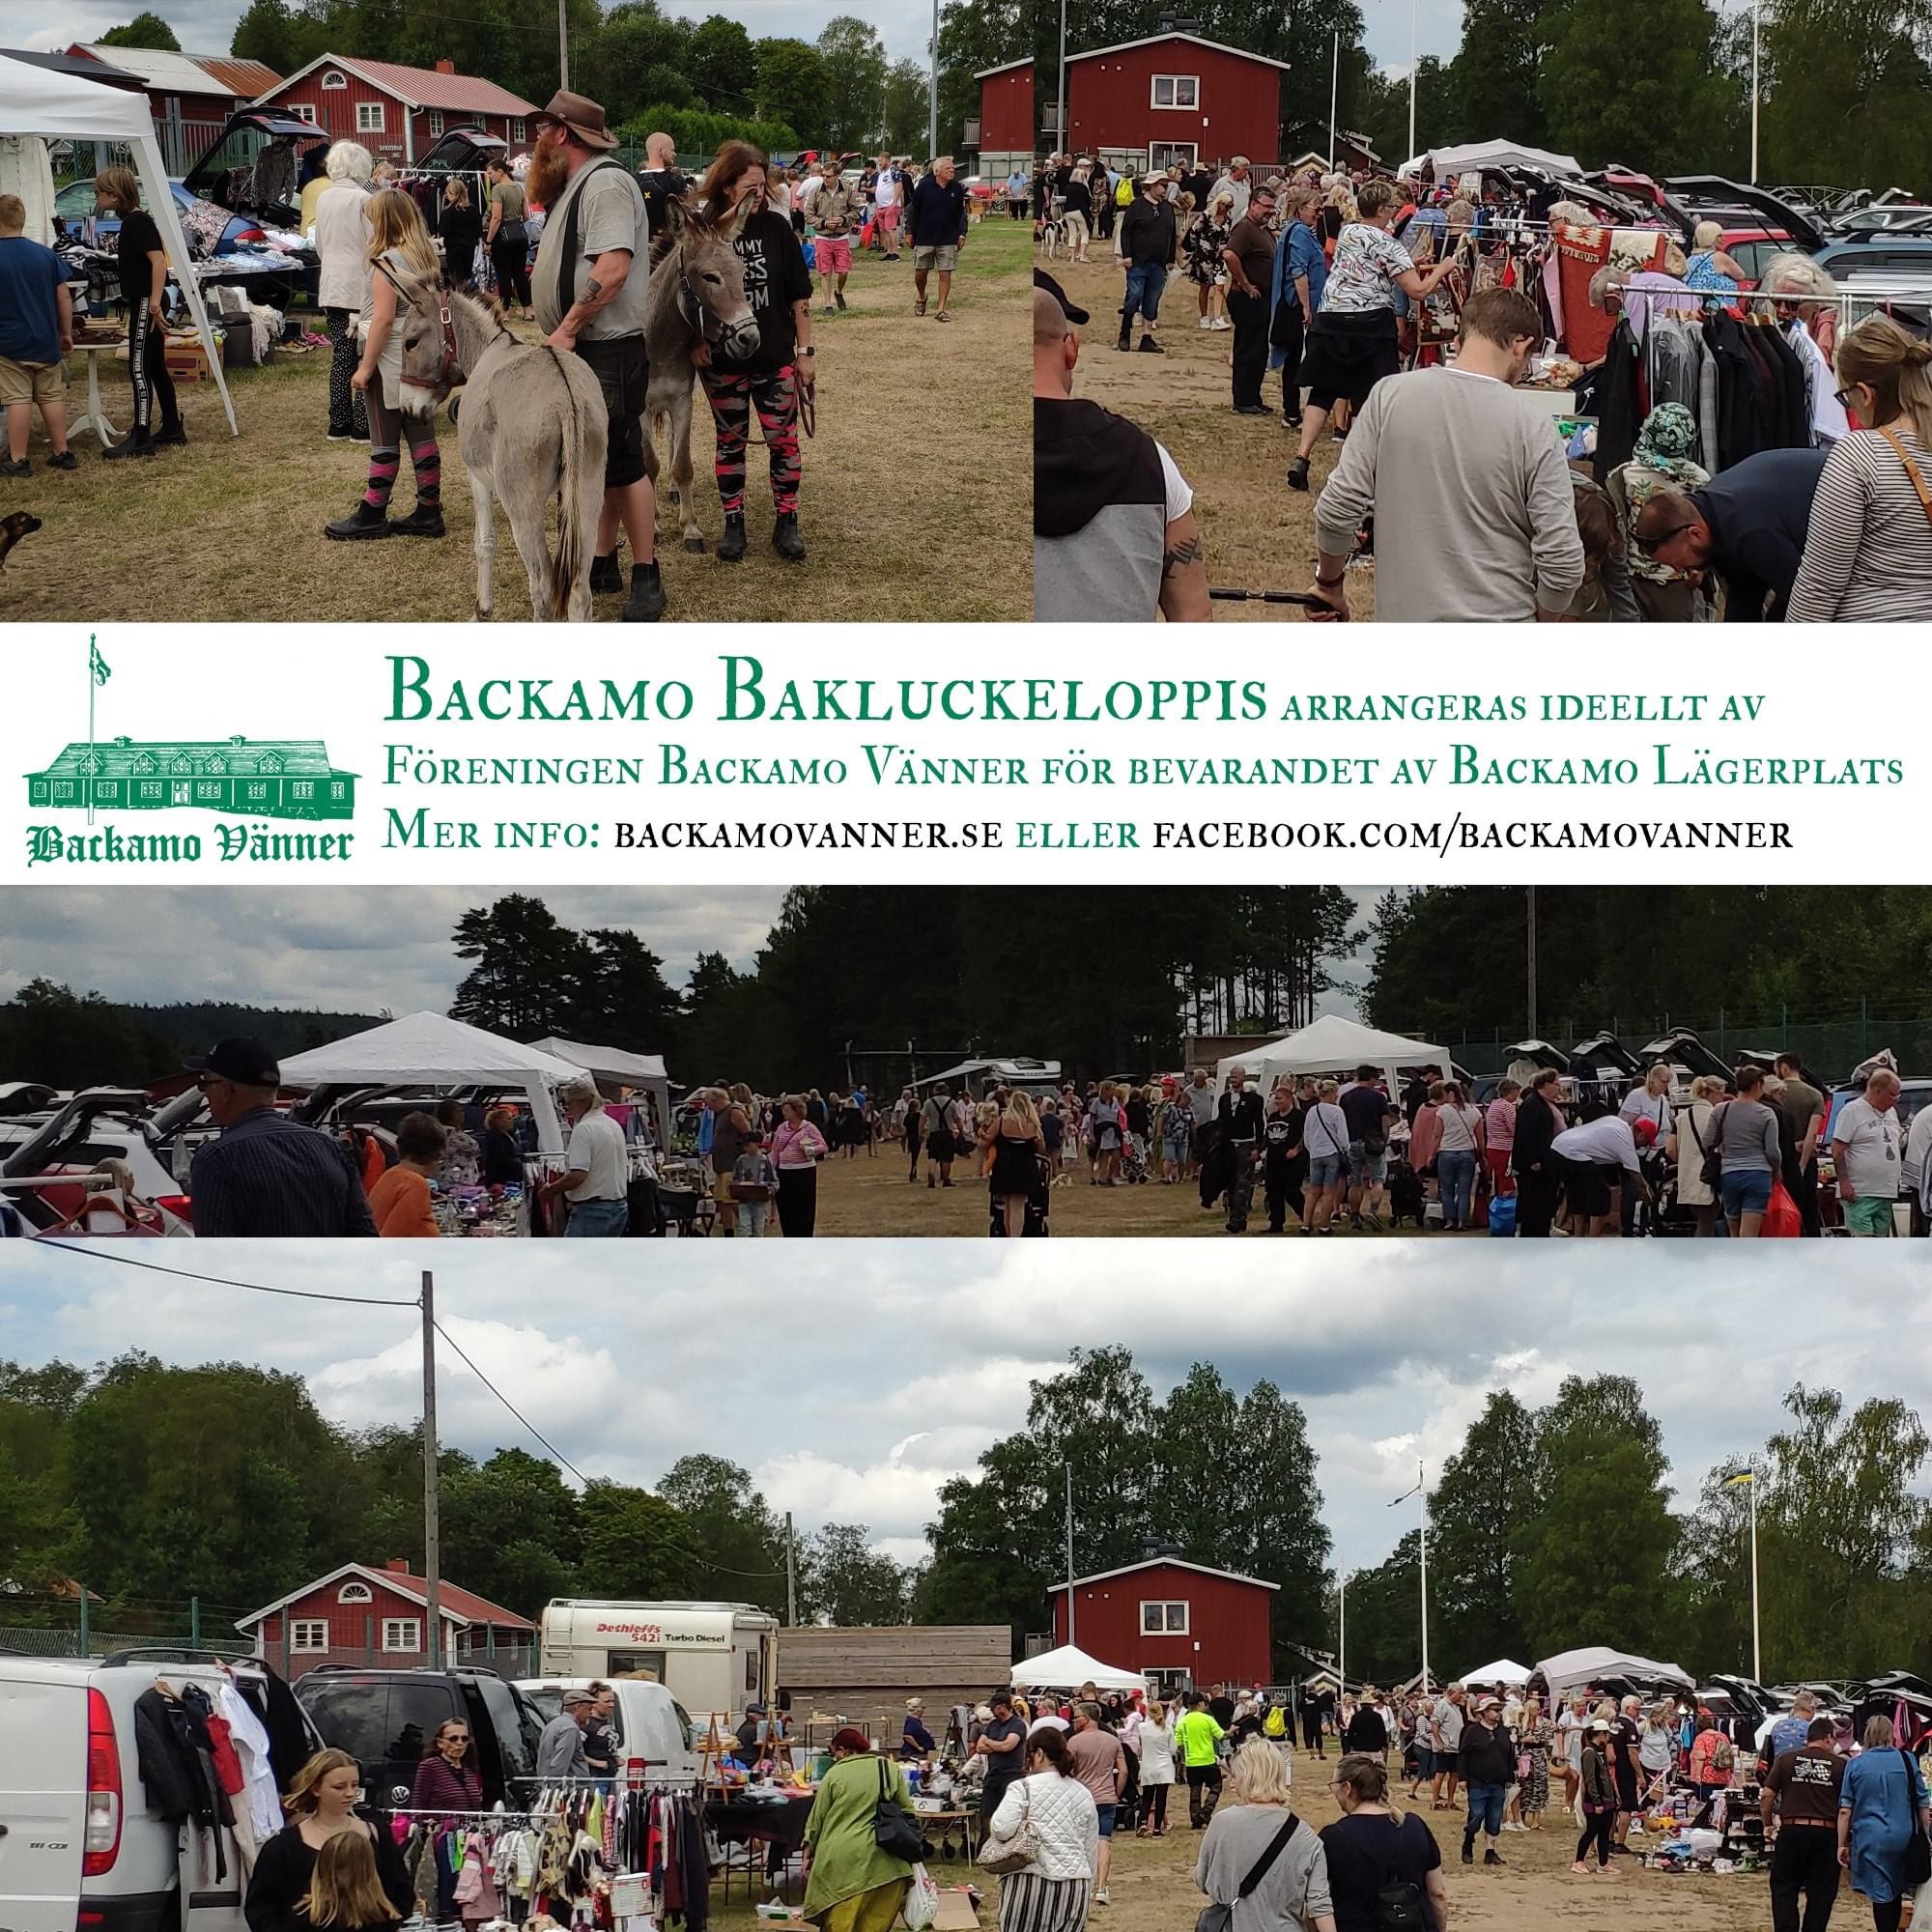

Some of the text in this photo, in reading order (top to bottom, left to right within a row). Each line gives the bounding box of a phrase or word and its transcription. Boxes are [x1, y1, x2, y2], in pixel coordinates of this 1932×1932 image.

[727, 240, 762, 254] MMY
[140, 297, 149, 320] FOREVER
[596, 1623, 662, 1633] Dethleffs
[631, 1633, 660, 1642] 542i
[665, 1634, 694, 1642] Turbo
